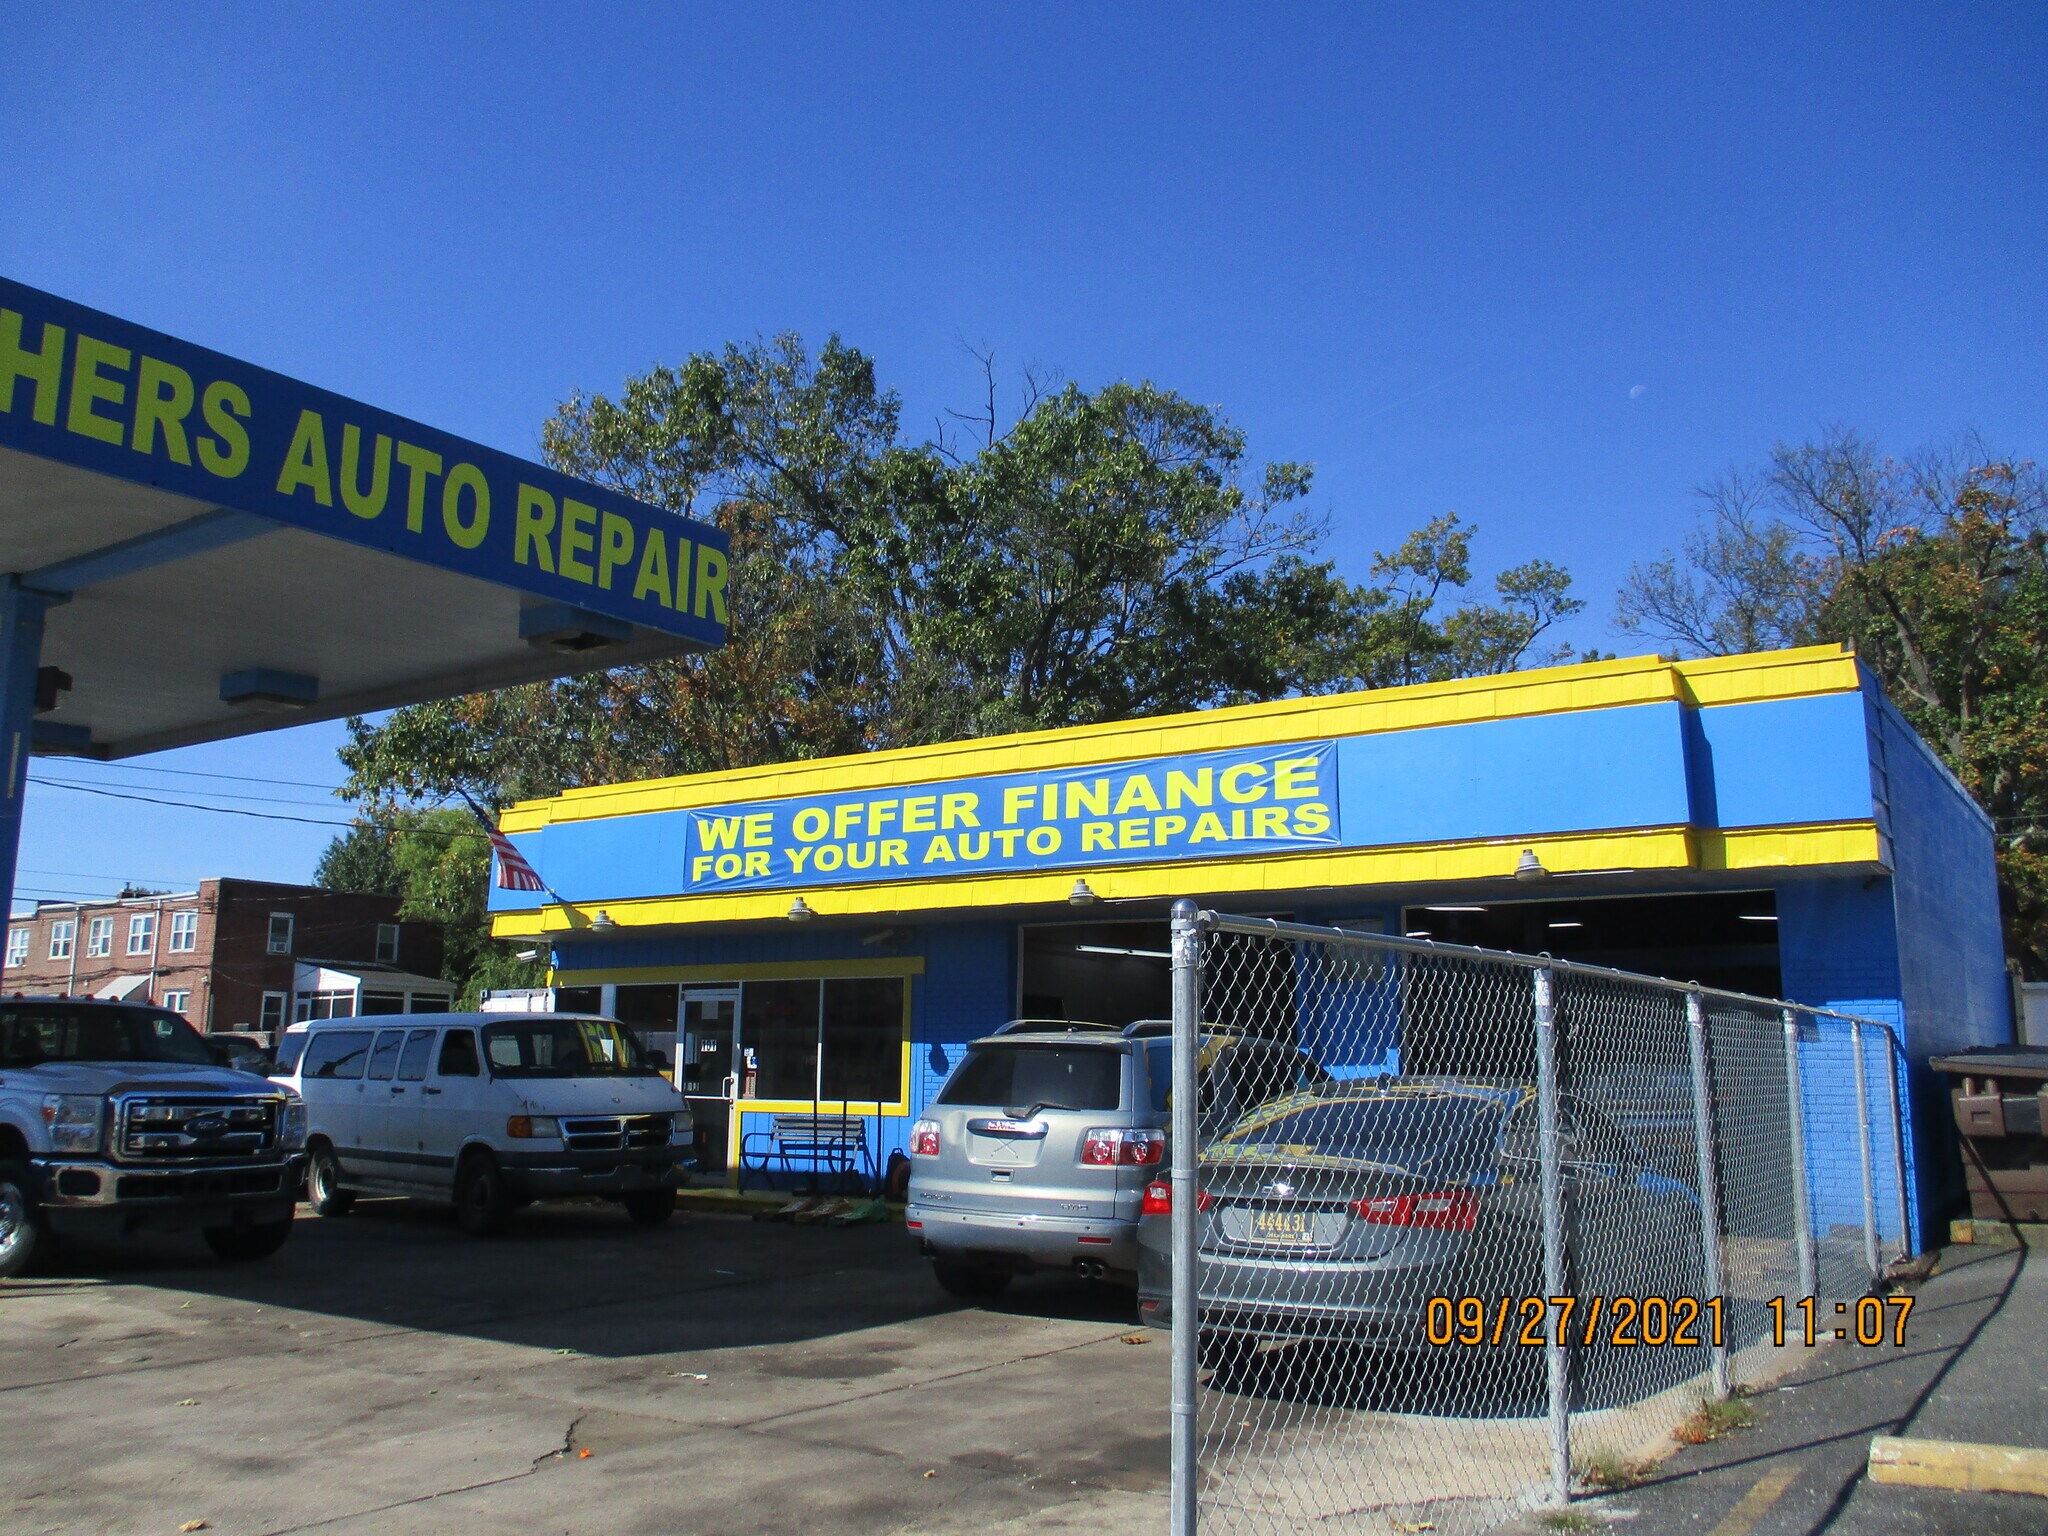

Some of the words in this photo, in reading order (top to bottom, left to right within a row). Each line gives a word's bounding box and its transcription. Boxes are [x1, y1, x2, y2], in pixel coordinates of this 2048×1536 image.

[0, 309, 251, 478] HERS
[277, 410, 490, 548] AUTO
[515, 484, 729, 625] REPAIR
[692, 850, 772, 882] FOR
[784, 838, 909, 874] YOUR
[923, 825, 1063, 864] AUTO
[1081, 802, 1331, 852] REPAIRS
[698, 812, 774, 852] WE
[793, 791, 981, 843] OFFER
[1004, 756, 1320, 825] FINANCE
